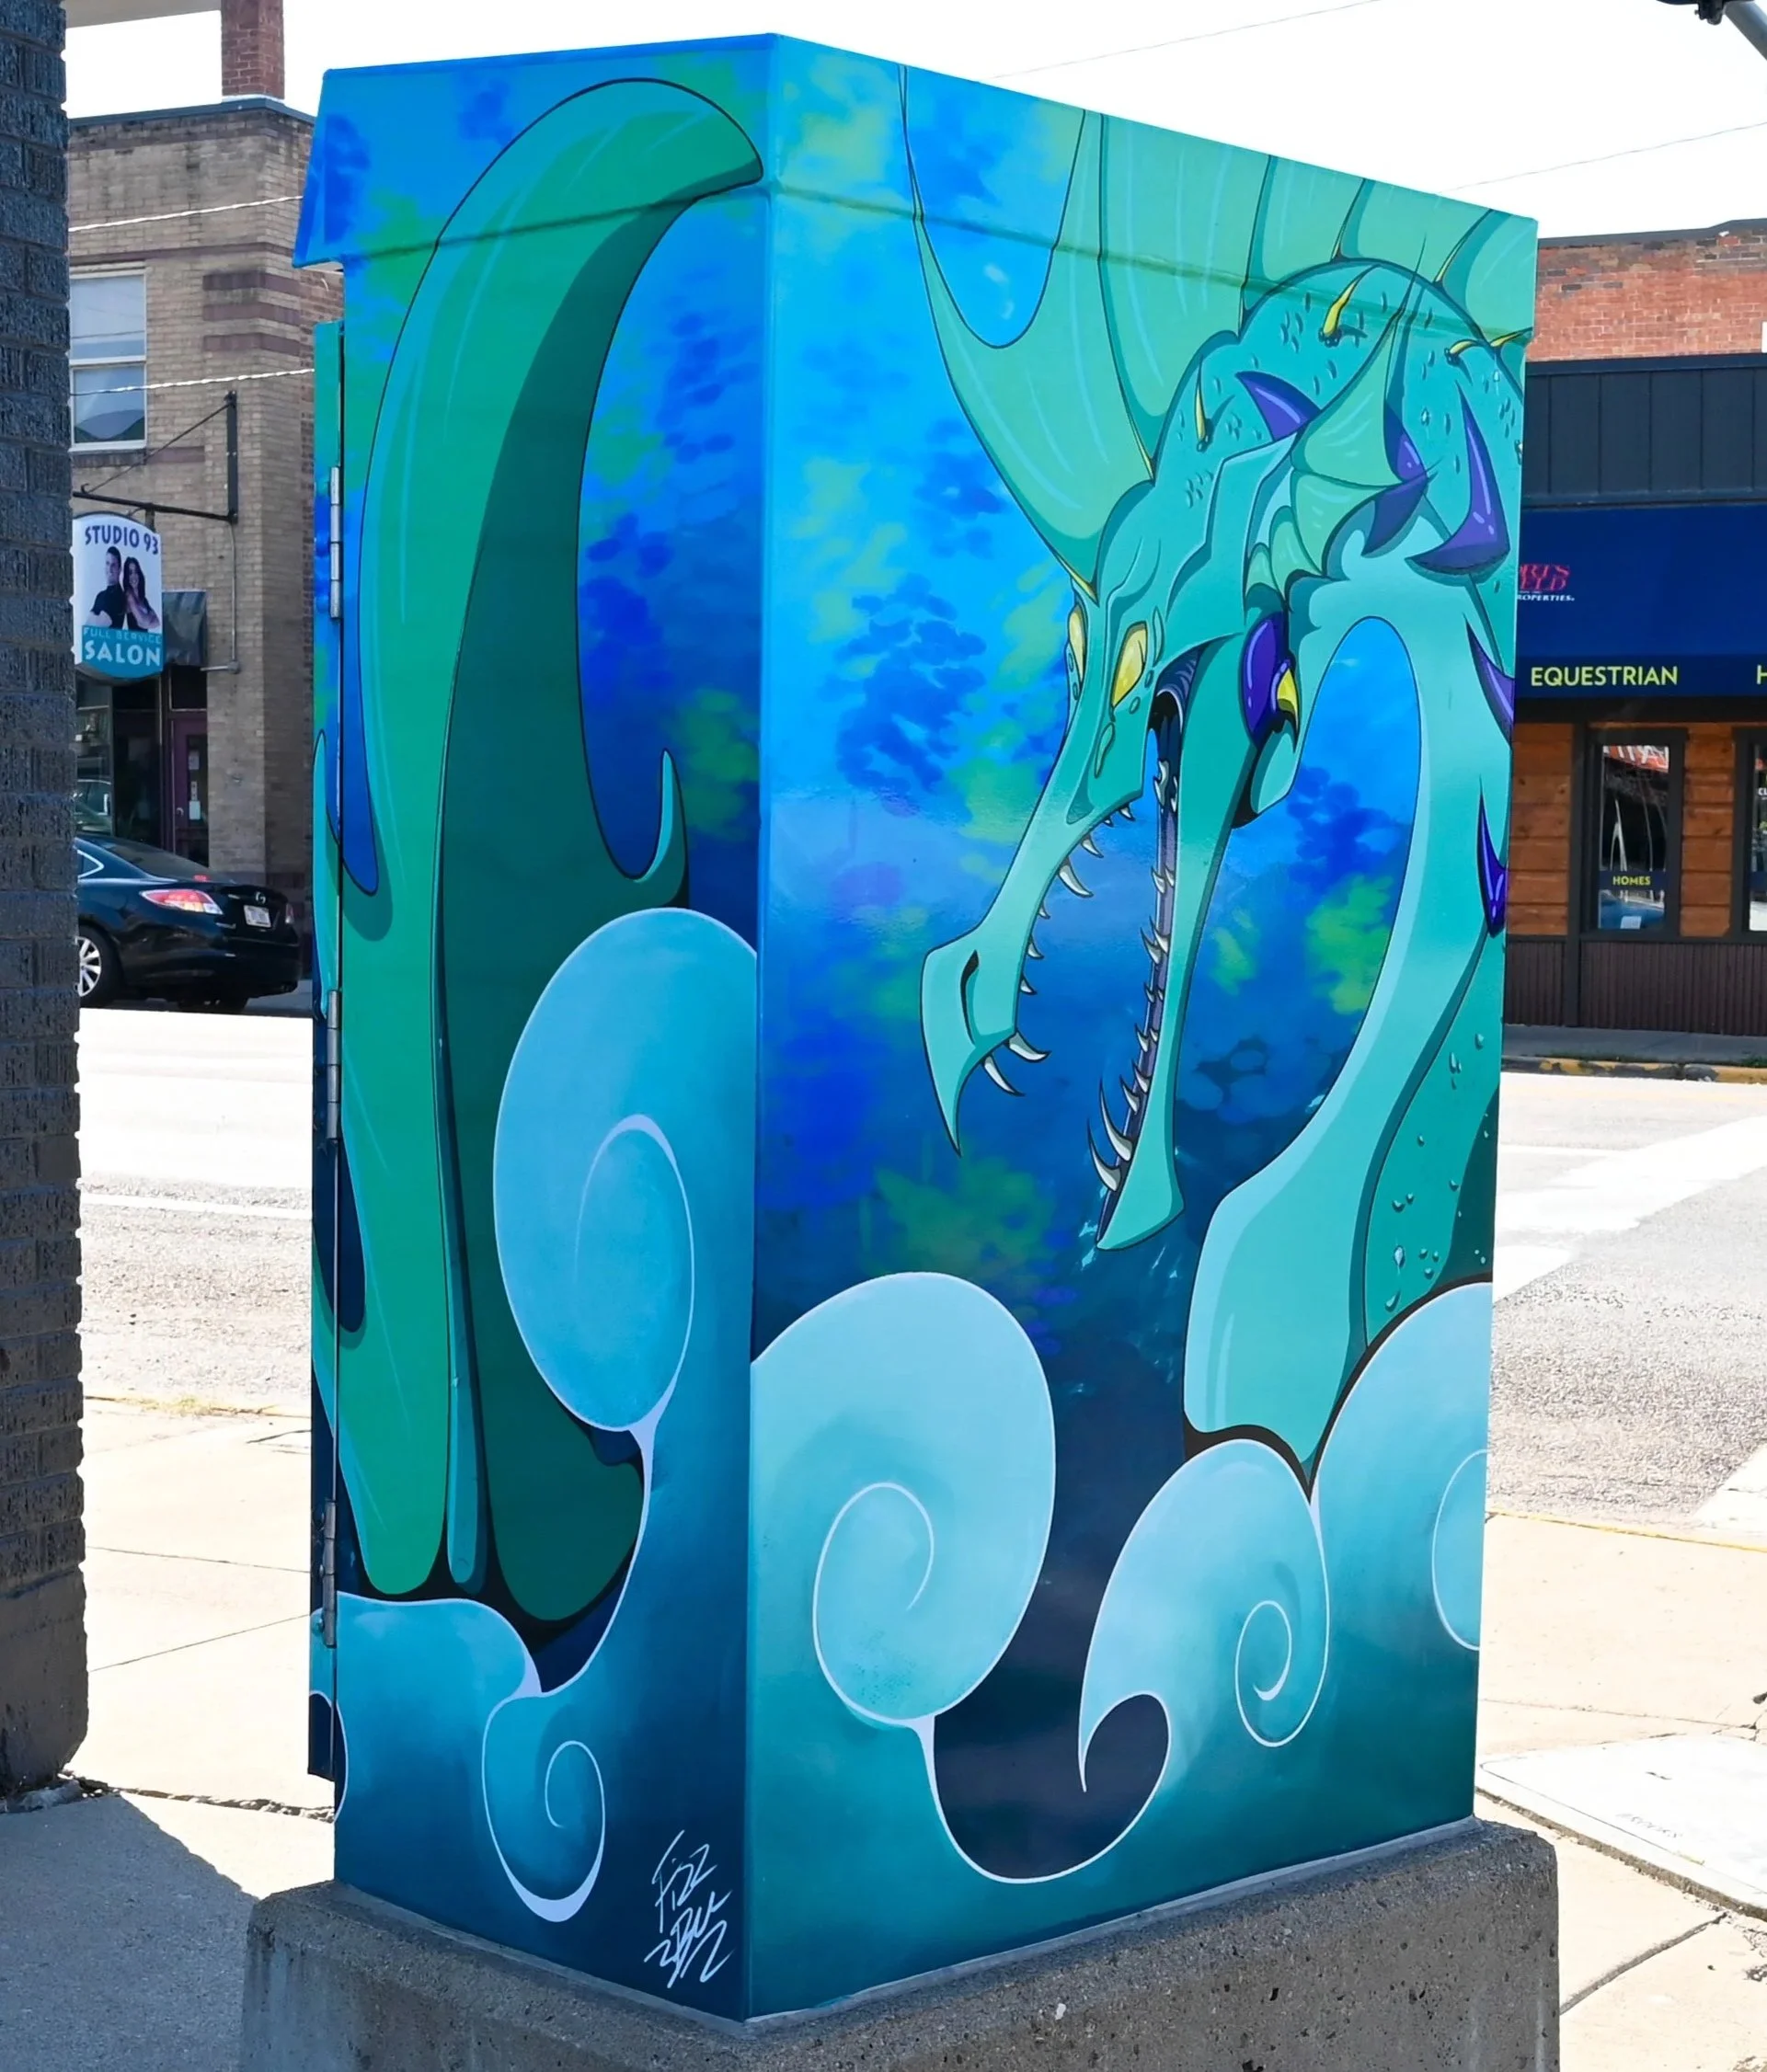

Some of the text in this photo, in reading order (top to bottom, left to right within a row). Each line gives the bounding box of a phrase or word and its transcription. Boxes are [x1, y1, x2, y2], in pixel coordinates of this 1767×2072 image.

[85, 524, 159, 555] STUDIO 93
[84, 626, 162, 645] FULL SERVICE
[85, 640, 161, 667] SALON
[1531, 665, 1679, 687] EQUESTRIAN
[1612, 876, 1652, 886] HOMES
